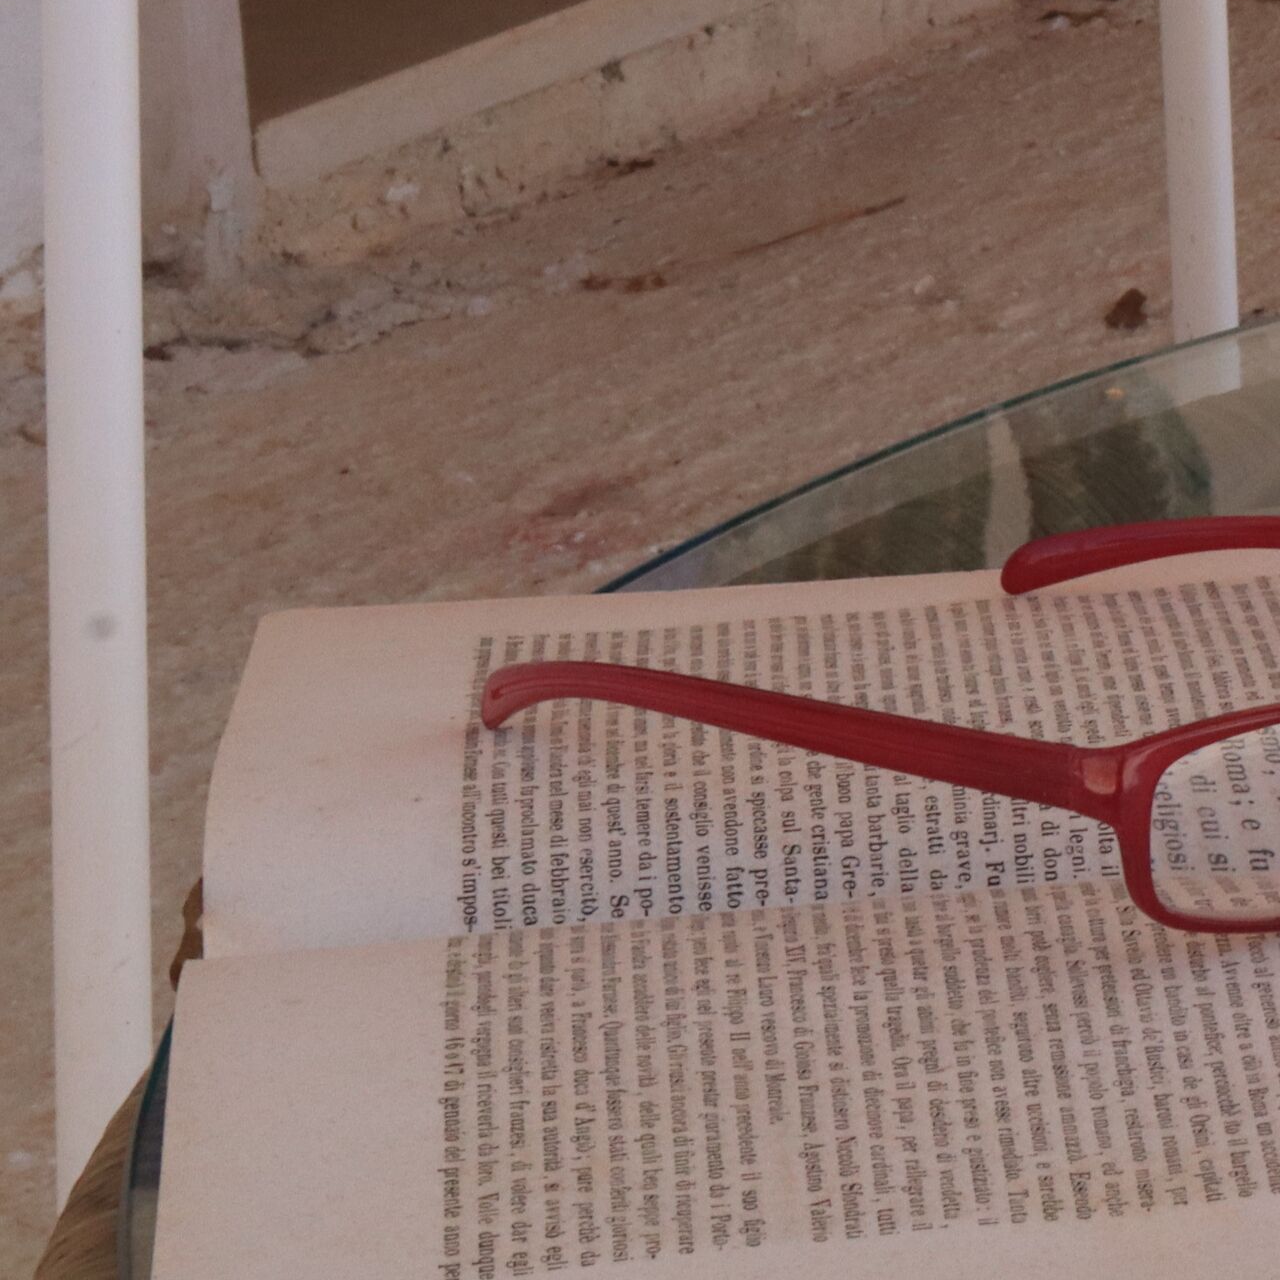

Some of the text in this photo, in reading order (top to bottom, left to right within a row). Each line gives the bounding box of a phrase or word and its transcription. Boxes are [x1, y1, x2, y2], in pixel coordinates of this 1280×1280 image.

[548, 779, 567, 798] nel
[634, 771, 655, 796] farsi
[485, 808, 508, 849] questi
[549, 799, 564, 832] mese
[635, 797, 653, 847] temere
[745, 791, 769, 860] spiccasse
[773, 770, 802, 904] colpa sul Santa-
[802, 760, 832, 901] che gente cristiana
[834, 771, 861, 899] buon papa Gre-
[864, 774, 889, 898] tanta barbarie,
[924, 795, 946, 856] estratti
[1197, 806, 1230, 841] cui
[490, 855, 511, 881] bei
[517, 797, 540, 927] proclamato duca
[576, 790, 597, 923] mai non esercitò,
[607, 839, 623, 884] anno.
[663, 797, 685, 915] sostentamento
[688, 780, 713, 912] consiglio venisse
[722, 787, 746, 910] avendone fatto
[890, 792, 919, 894] taglio della
[949, 830, 972, 890] grave,
[1013, 832, 1035, 885] nobili
[1043, 847, 1061, 882] don
[1065, 827, 1091, 880] legni.
[456, 857, 482, 934] s'impos-
[492, 887, 513, 931] titoli
[550, 852, 570, 925] febbraio
[632, 887, 654, 918] po-
[748, 868, 770, 907] pre-
[436, 1096, 463, 1219] gennaio presente
[697, 1112, 726, 1180] giuramento
[729, 1103, 766, 1248] precedente figlio
[798, 1142, 833, 1243] Agostino Valerio
[1037, 1175, 1065, 1222] sarebbe
[1068, 1171, 1097, 1221] Essendo
[1193, 1158, 1227, 1203] capitati
[571, 1201, 601, 1244] perchè
[840, 1181, 867, 1240] Sfondrati
[1007, 1188, 1029, 1224] Tanta
[471, 1231, 499, 1280] dunque
[540, 1245, 568, 1272] egli
[604, 1215, 634, 1263] gloriosi
